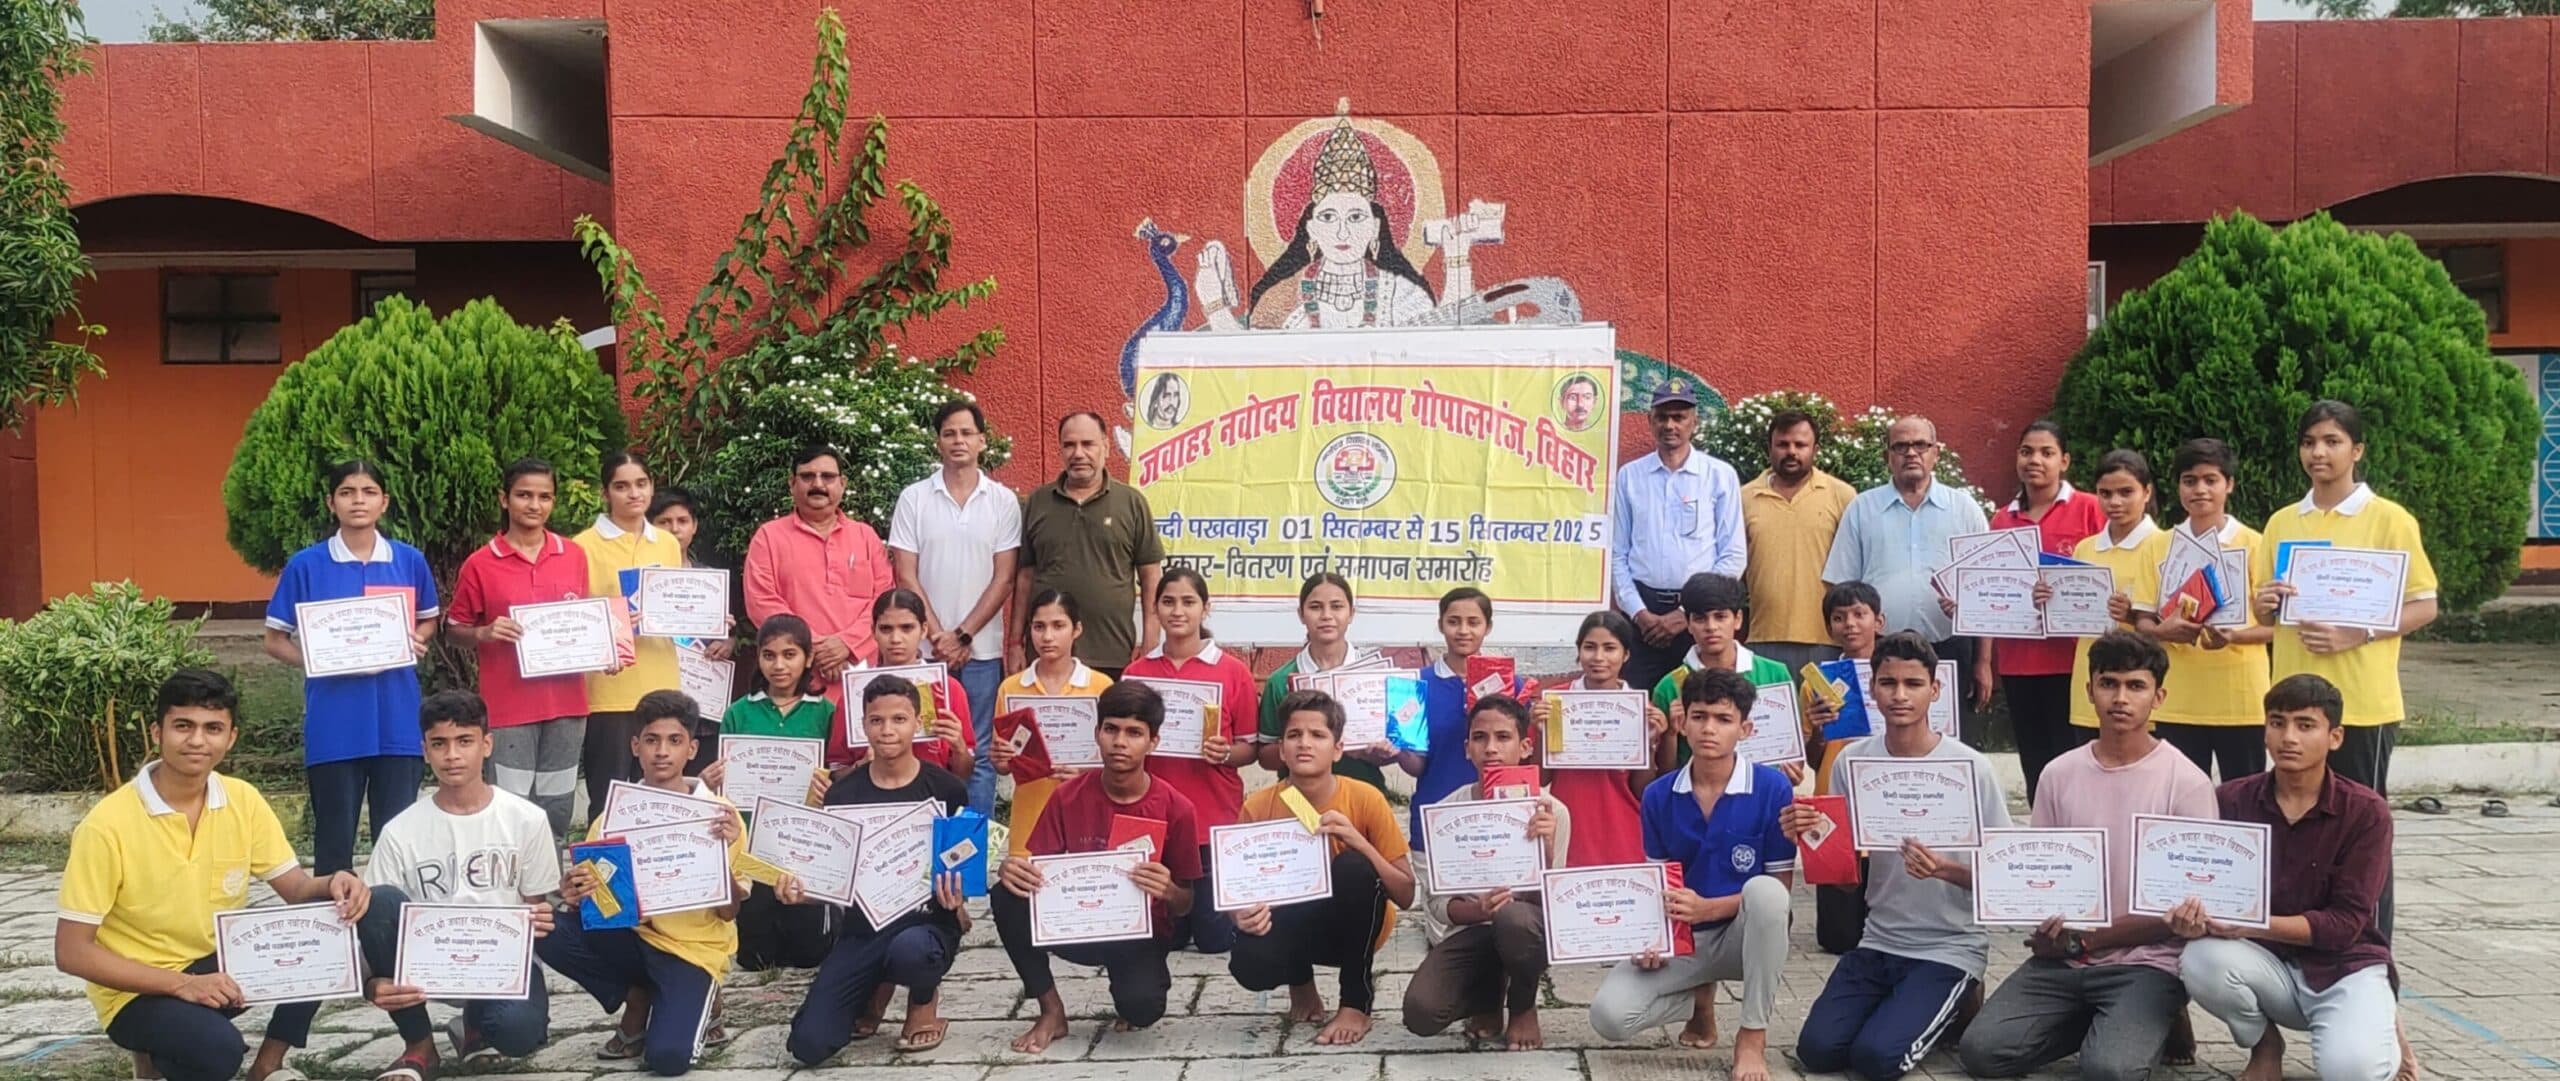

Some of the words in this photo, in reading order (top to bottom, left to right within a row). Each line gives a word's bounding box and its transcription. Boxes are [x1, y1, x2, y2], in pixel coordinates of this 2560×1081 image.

[1138, 419, 1215, 487] जवाहर
[1219, 393, 1300, 446] नवोदय
[1312, 378, 1406, 425] विद्यालय
[1154, 511, 1184, 538] न्दी
[1188, 519, 1268, 545] पखवाड़ा
[1283, 518, 1313, 540] 01
[1322, 513, 1402, 540] सितम्बर
[1405, 515, 1424, 541] से
[1430, 522, 1459, 543] 15
[1469, 514, 1550, 541] सितम्बर
[1300, 545, 1333, 580] एवं
[1335, 556, 1411, 581] समापन
[1416, 550, 1494, 581] समारोह
[417, 852, 517, 899] RIEN
